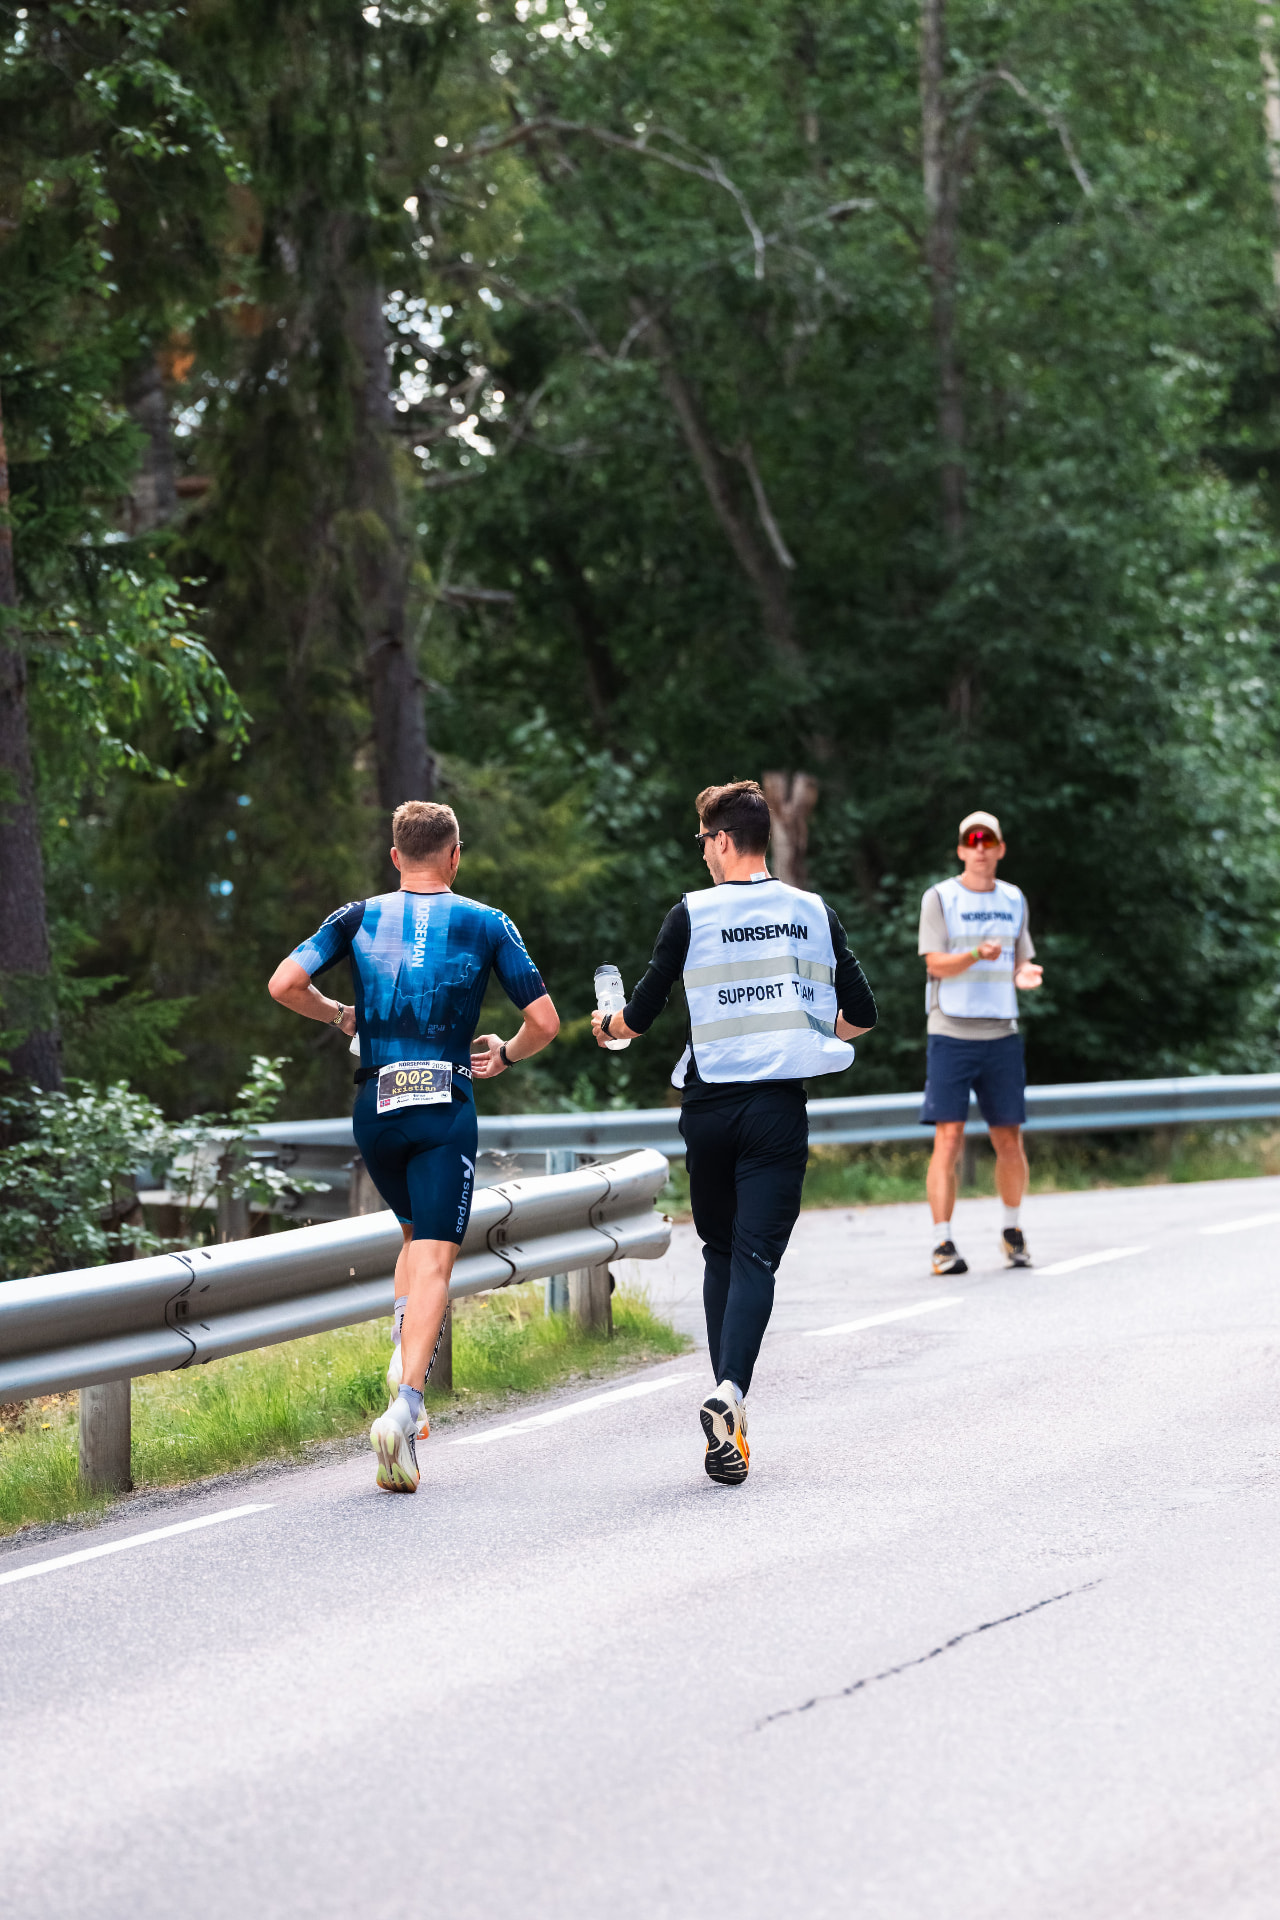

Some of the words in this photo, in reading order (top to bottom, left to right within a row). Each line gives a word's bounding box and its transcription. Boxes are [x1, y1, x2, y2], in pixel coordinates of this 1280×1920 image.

[961, 911, 1013, 921] NORSEMAN
[412, 898, 431, 968] NORSEMAN
[721, 924, 808, 943] NORSEMAN
[718, 983, 784, 1005] SUPPORT
[792, 980, 815, 1002] TAM
[395, 1070, 434, 1087] 002
[392, 1084, 437, 1095] Kristian
[455, 1181, 470, 1234] surpas
